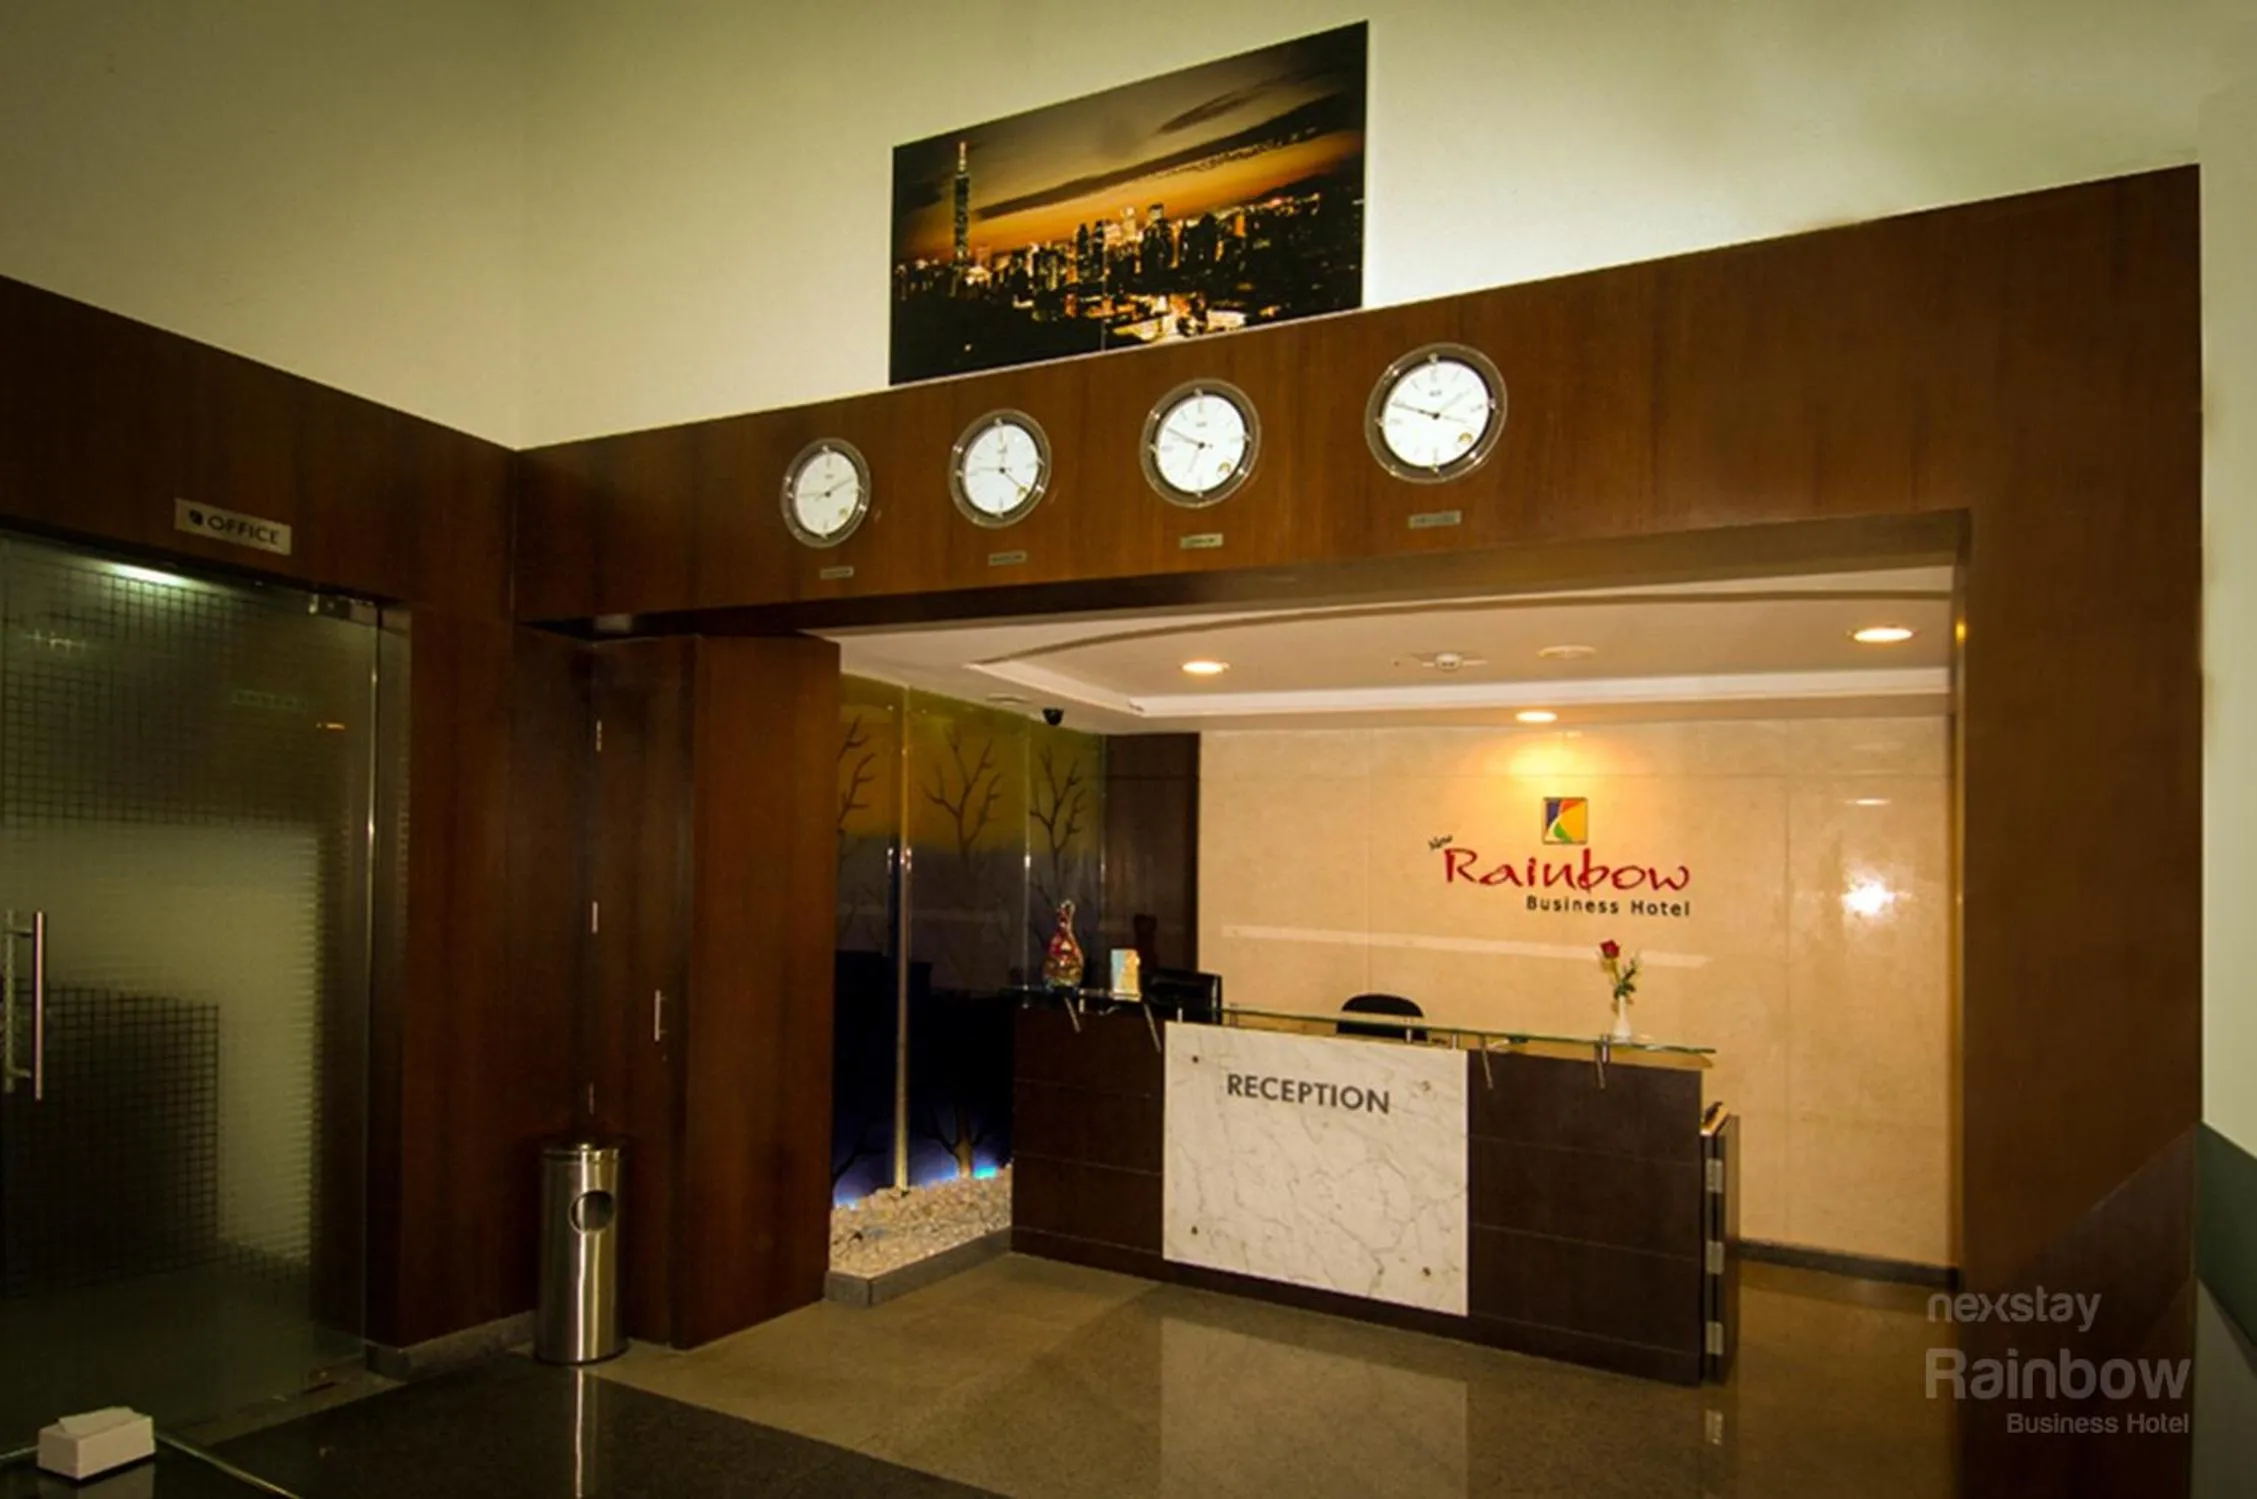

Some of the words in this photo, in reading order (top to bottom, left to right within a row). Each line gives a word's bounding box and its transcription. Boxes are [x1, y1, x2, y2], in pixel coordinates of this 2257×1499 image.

[207, 515, 280, 544] OFFICE
[1444, 847, 1690, 893] Rainbow
[1525, 895, 1620, 914] Business
[1630, 900, 1690, 917] Hotel
[1227, 1073, 1390, 1115] RECEPTION
